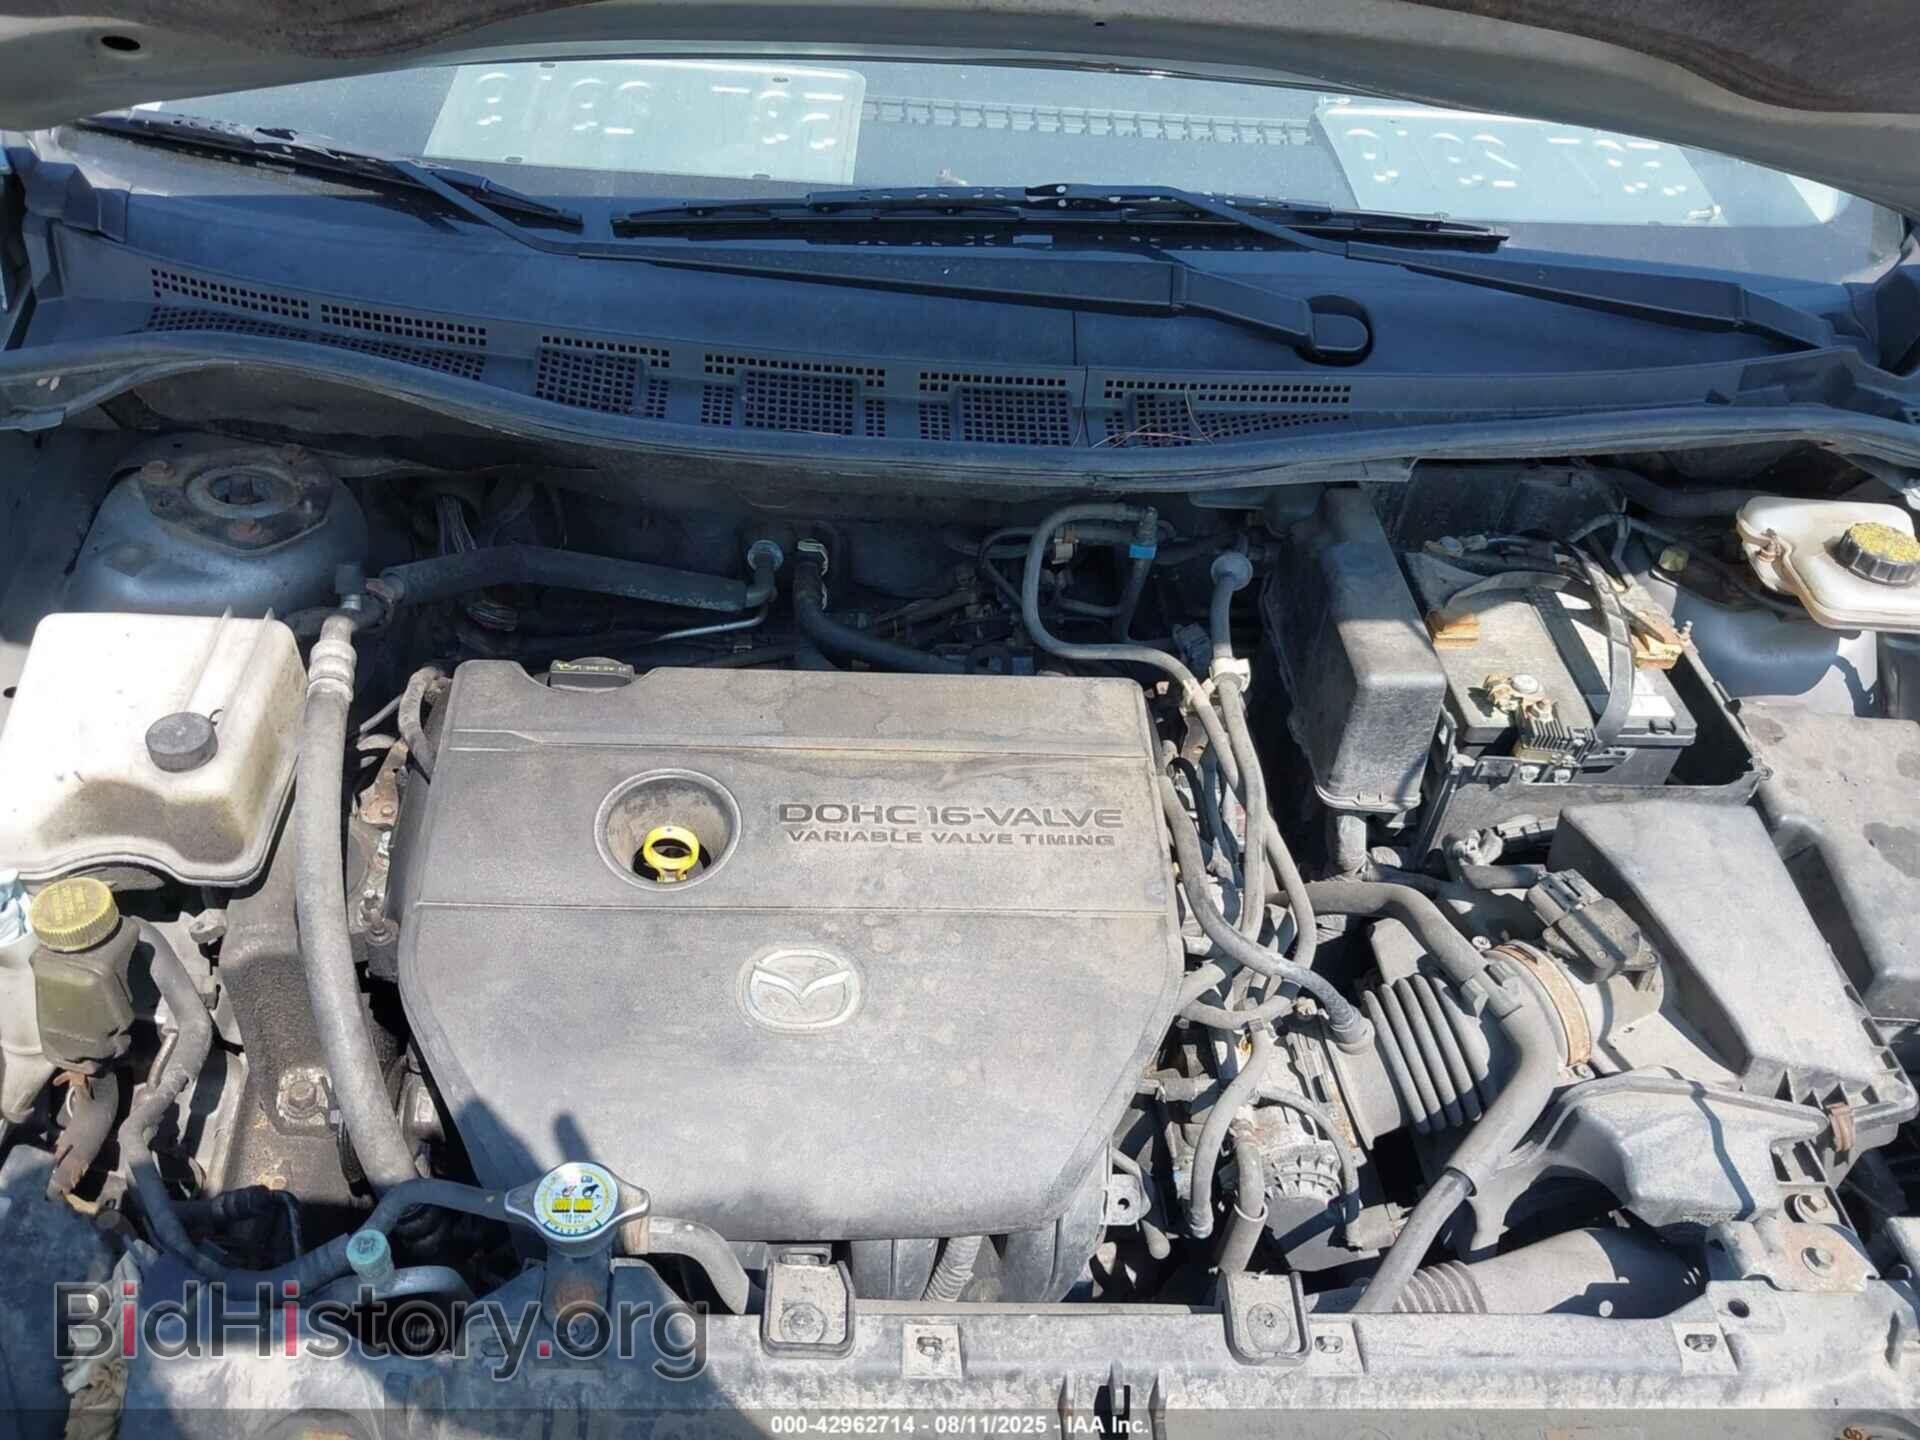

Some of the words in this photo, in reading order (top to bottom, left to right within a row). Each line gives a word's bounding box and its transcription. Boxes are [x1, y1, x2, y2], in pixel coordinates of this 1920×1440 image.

[778, 803, 917, 825] DOHC
[927, 806, 1123, 829] 16-VALVE
[787, 829, 923, 844] VARIABLE
[931, 831, 1014, 846] VALVE
[1019, 833, 1116, 847] TIMING
